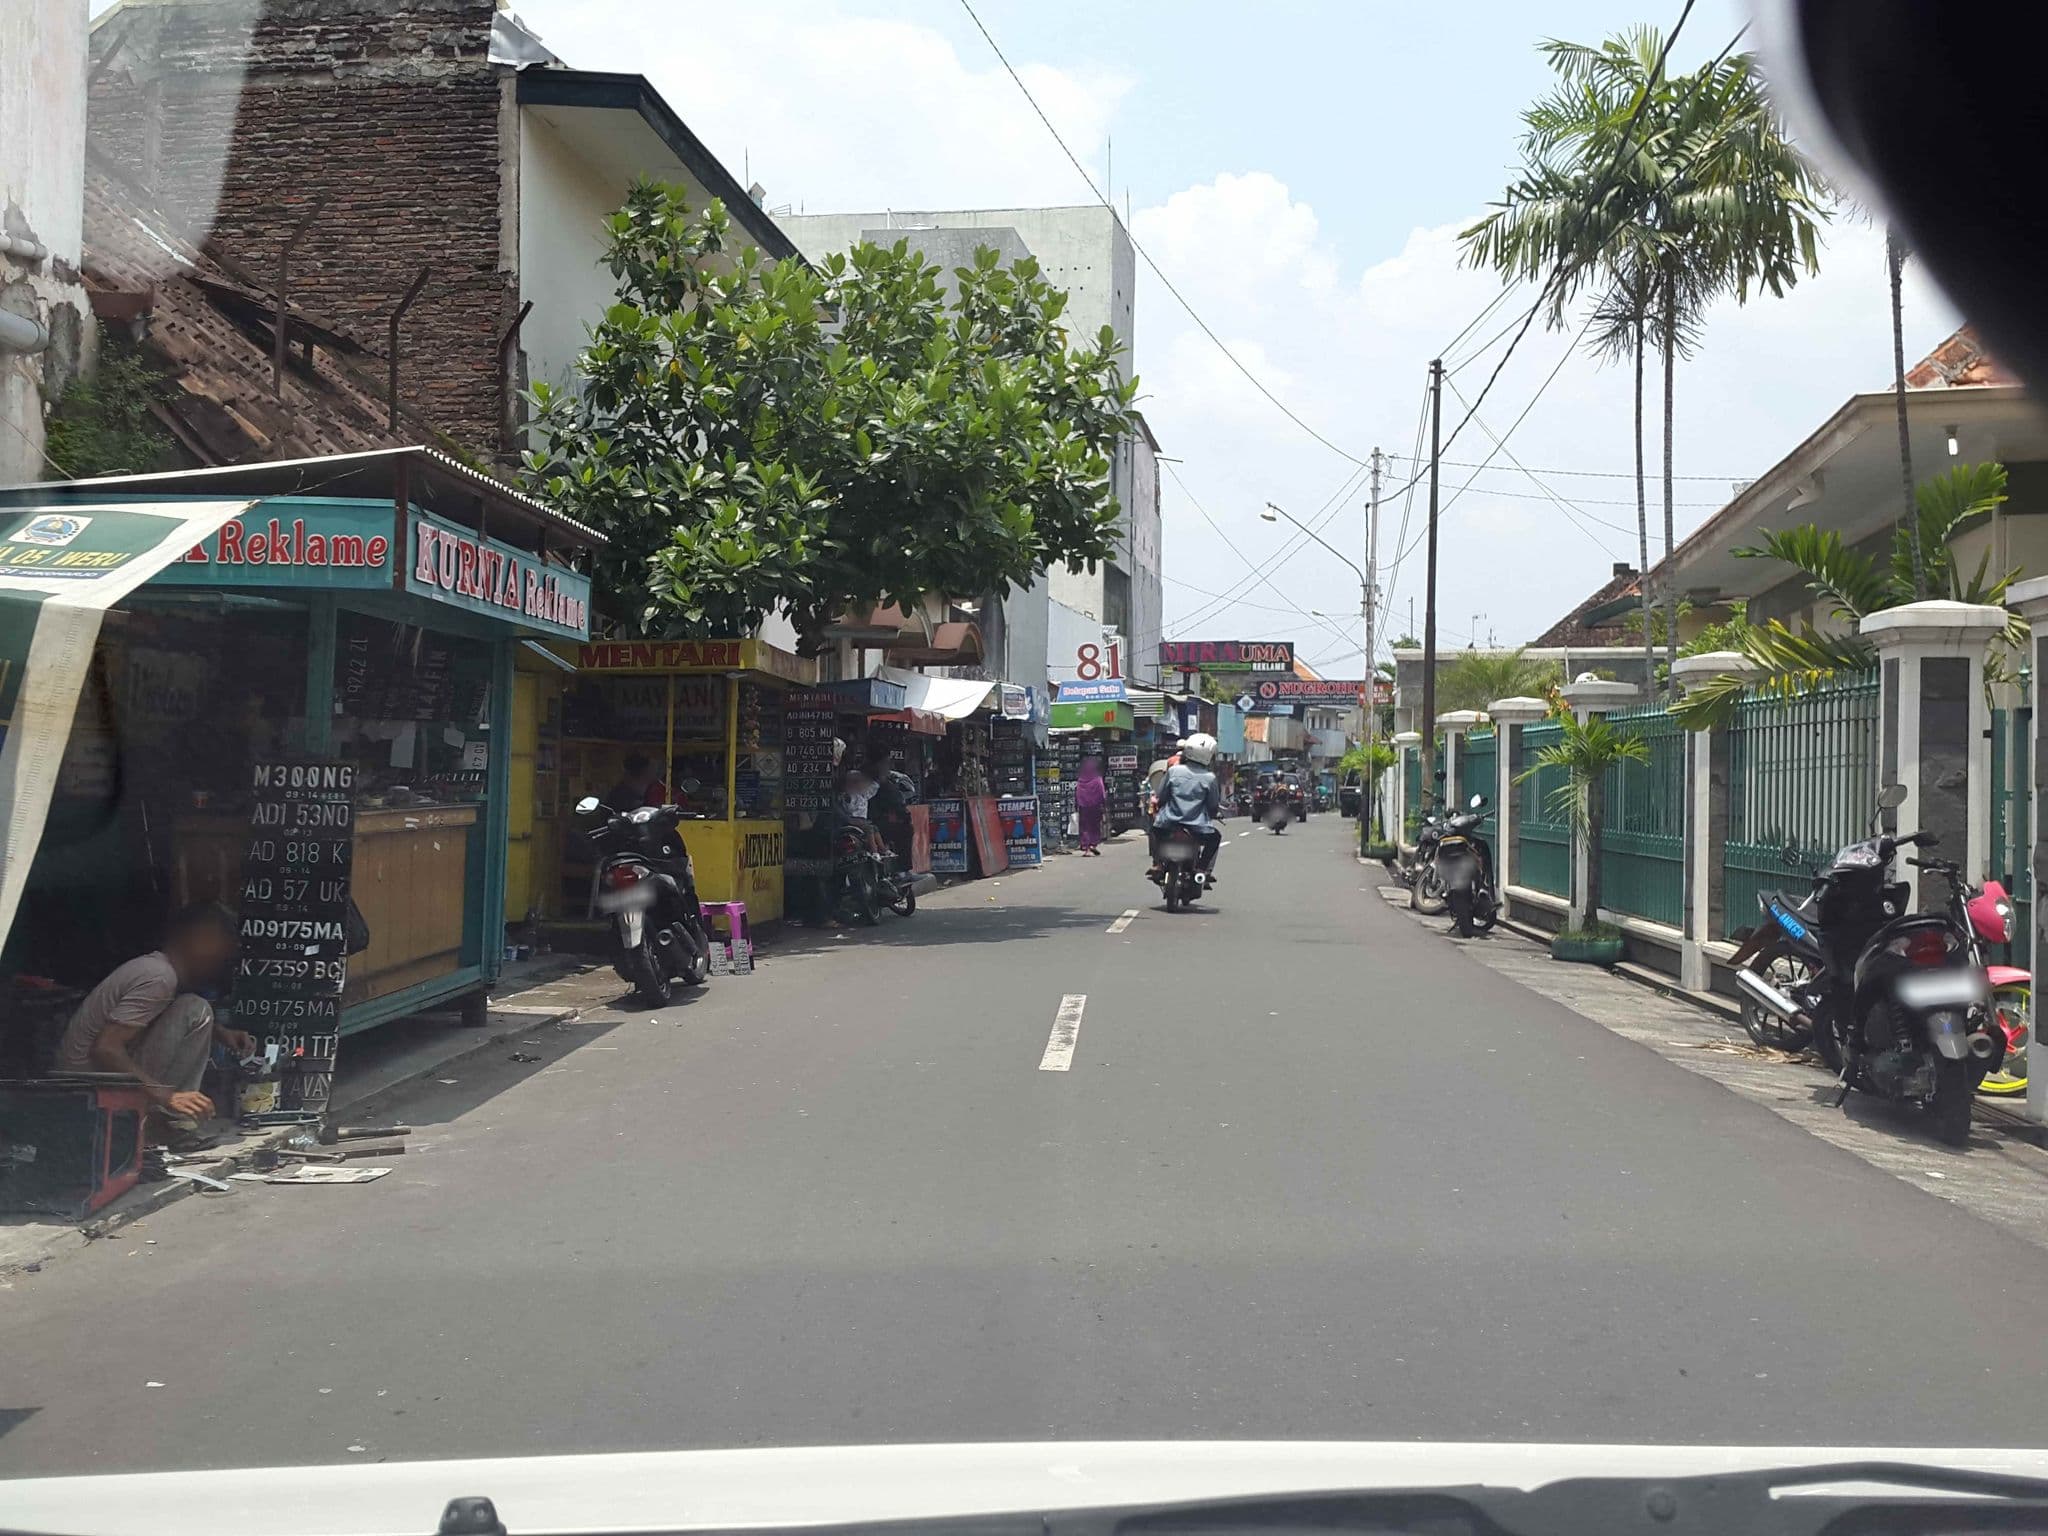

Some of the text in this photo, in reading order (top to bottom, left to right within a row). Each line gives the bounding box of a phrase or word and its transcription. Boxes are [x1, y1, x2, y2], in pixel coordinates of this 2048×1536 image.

[215, 517, 388, 568] Reklame
[53, 551, 132, 567] WERU
[416, 521, 586, 631] KURNIA Reklame
[578, 642, 741, 668] MENTARI
[1075, 640, 1127, 681] 81
[1163, 641, 1291, 663] MIRA UMA
[802, 762, 820, 773] 234
[997, 800, 1036, 813] STEMPEL
[249, 840, 343, 864] AD 818 K
[744, 832, 785, 868] MENTARI
[245, 878, 345, 903] AD 57 UK
[241, 919, 344, 940] AD9175MA
[240, 958, 253, 976] K
[258, 959, 309, 977] 7359
[235, 999, 336, 1017] AD9175MA
[311, 1035, 334, 1057] TT
